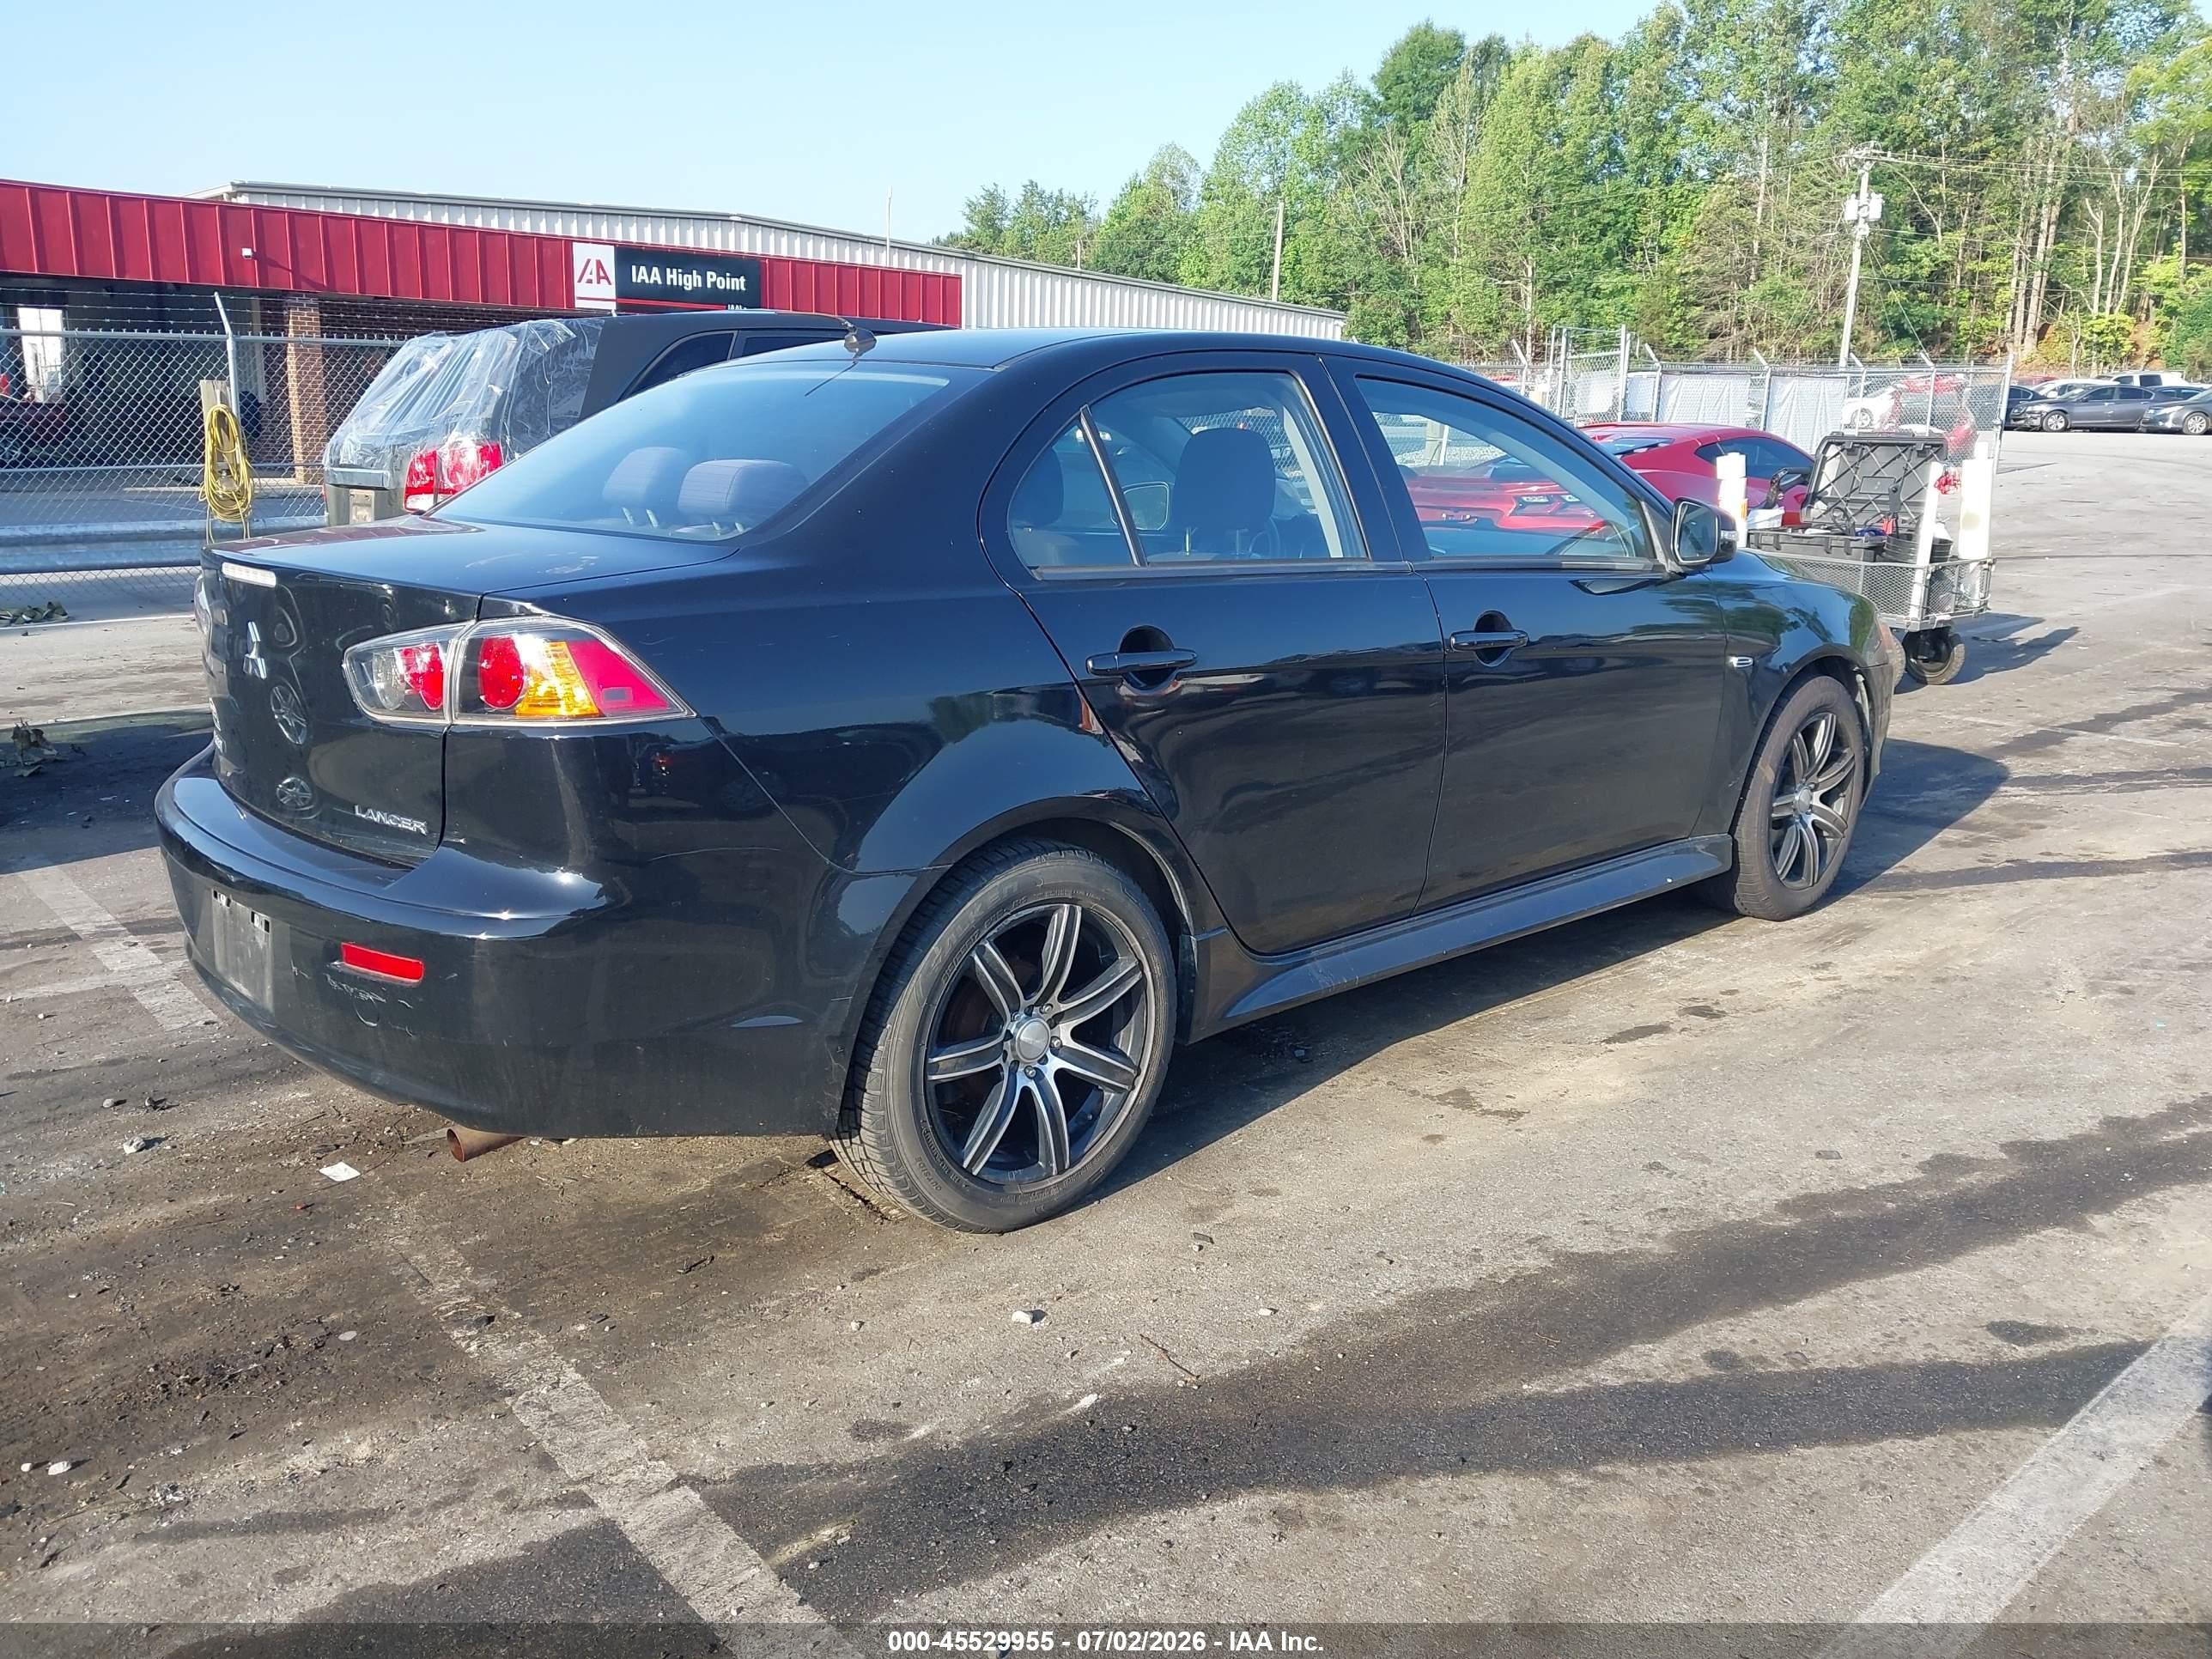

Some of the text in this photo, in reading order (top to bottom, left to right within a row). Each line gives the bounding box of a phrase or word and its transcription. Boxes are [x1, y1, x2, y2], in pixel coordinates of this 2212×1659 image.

[631, 264, 746, 292] IAA High Point
[354, 804, 429, 836] LANCER
